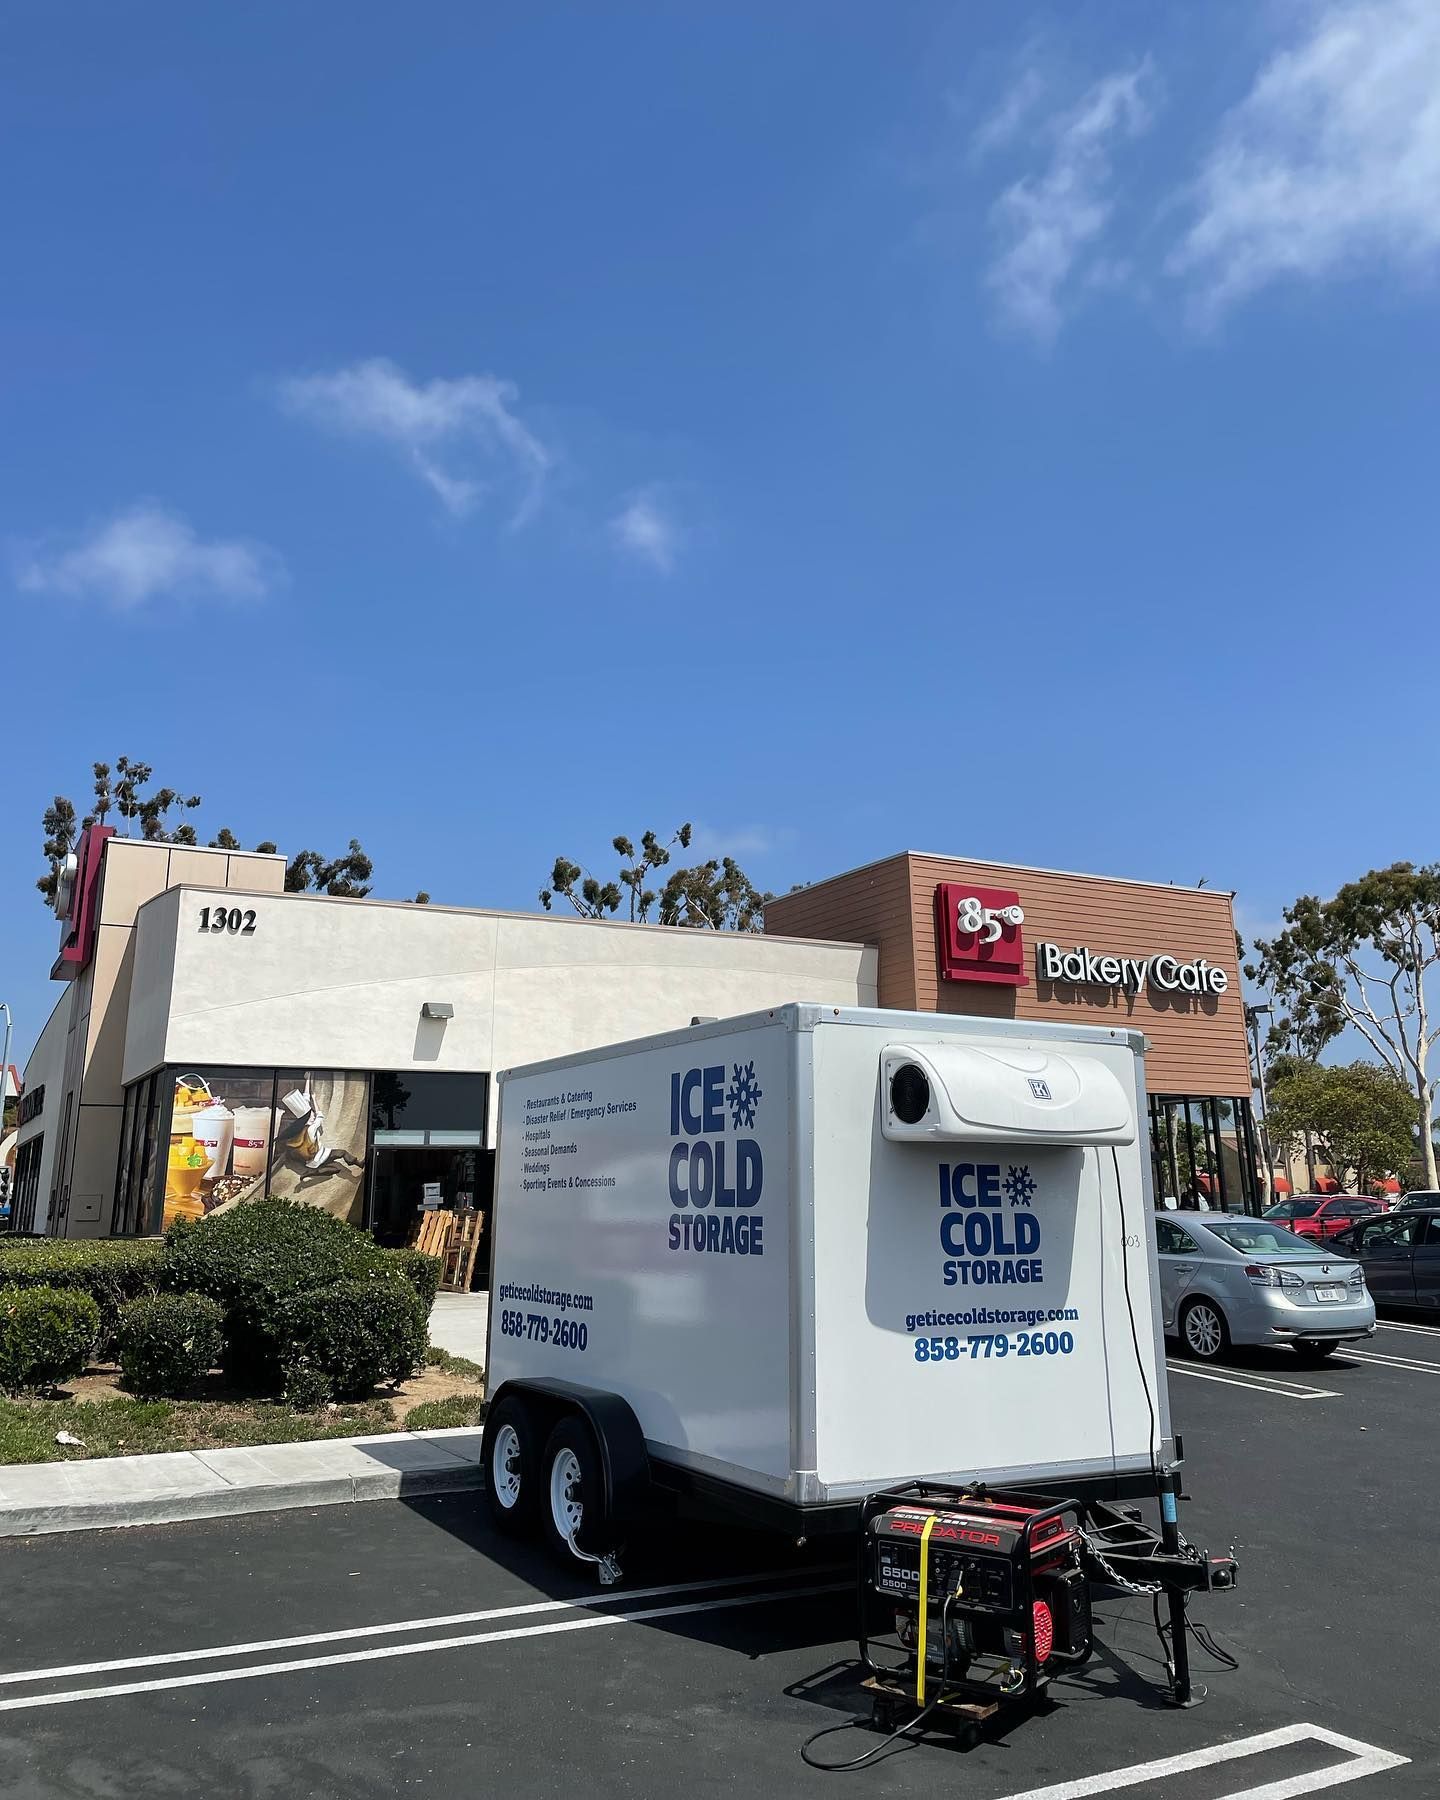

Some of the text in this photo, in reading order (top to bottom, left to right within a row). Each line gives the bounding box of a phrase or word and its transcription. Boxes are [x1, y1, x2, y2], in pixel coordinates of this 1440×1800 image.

[199, 906, 257, 932] 1302
[1041, 942, 1228, 994] Bakery Cafe
[526, 1089, 593, 1110] Restaurants & Catering
[670, 1065, 726, 1136] ICE
[525, 1114, 549, 1126] Disaster
[550, 1109, 567, 1122] Relief
[571, 1106, 606, 1120] Emergency
[606, 1101, 637, 1115] Services
[525, 1129, 551, 1142] Hospitals
[524, 1142, 578, 1158] Seasonal Demands
[523, 1162, 550, 1175] Weddings
[668, 1138, 764, 1209] COLD
[523, 1176, 616, 1192] Sporting Events & Concessions
[938, 1163, 1002, 1208] ICE
[668, 1213, 764, 1256] STORAGE
[940, 1212, 1041, 1257] COLD
[943, 1259, 1044, 1286] STORAGE
[499, 1281, 594, 1312] geticecoldstorage.com
[501, 1309, 588, 1351] 858-779-2600
[905, 1307, 1080, 1332] geticecoldstorage.com
[914, 1331, 1074, 1362] 858-779-2600
[882, 1565, 921, 1581] 6500
[882, 1578, 907, 1589] 5500
